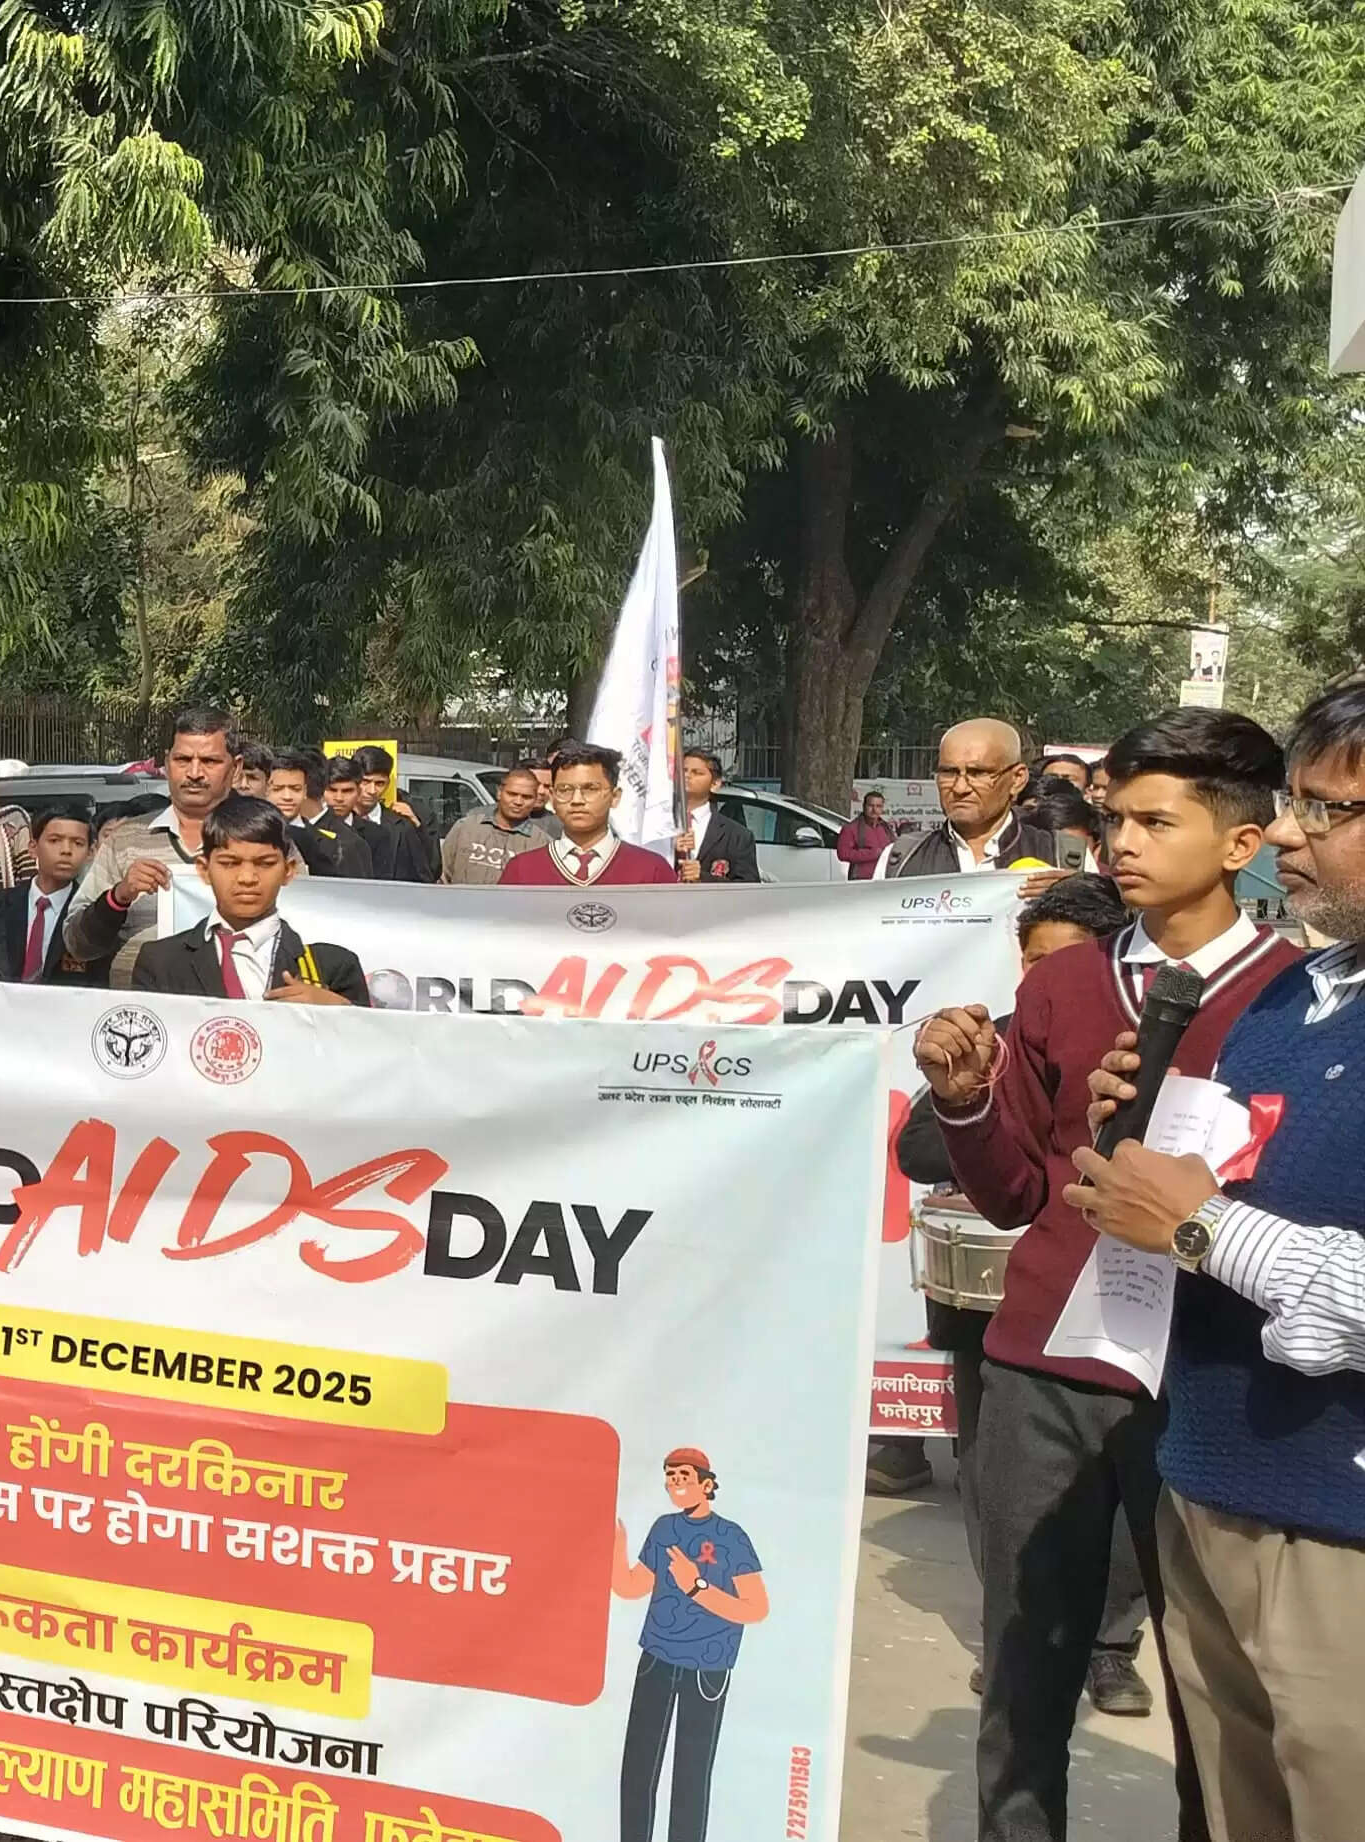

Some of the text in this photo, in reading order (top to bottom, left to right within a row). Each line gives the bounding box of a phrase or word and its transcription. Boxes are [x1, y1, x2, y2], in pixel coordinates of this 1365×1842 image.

[361, 955, 922, 1024] ORLD AIDS DAY
[423, 1190, 654, 1296] DAY
[0, 1325, 44, 1357] 1ST
[51, 1334, 264, 1393] DECEMBER
[272, 1363, 374, 1408] 2025
[876, 1398, 943, 1426] फतेहपुर
[7, 1414, 114, 1478] होंगी
[123, 1436, 348, 1511] दरकिनार
[31, 1487, 97, 1533] पर
[103, 1489, 214, 1554] होगा
[222, 1516, 379, 1576] सशक्त
[388, 1540, 512, 1596] प्रहार
[126, 1618, 347, 1694] कार्यक्रम
[142, 1698, 384, 1777] परियोजना
[118, 1764, 340, 1842] महासमिति
